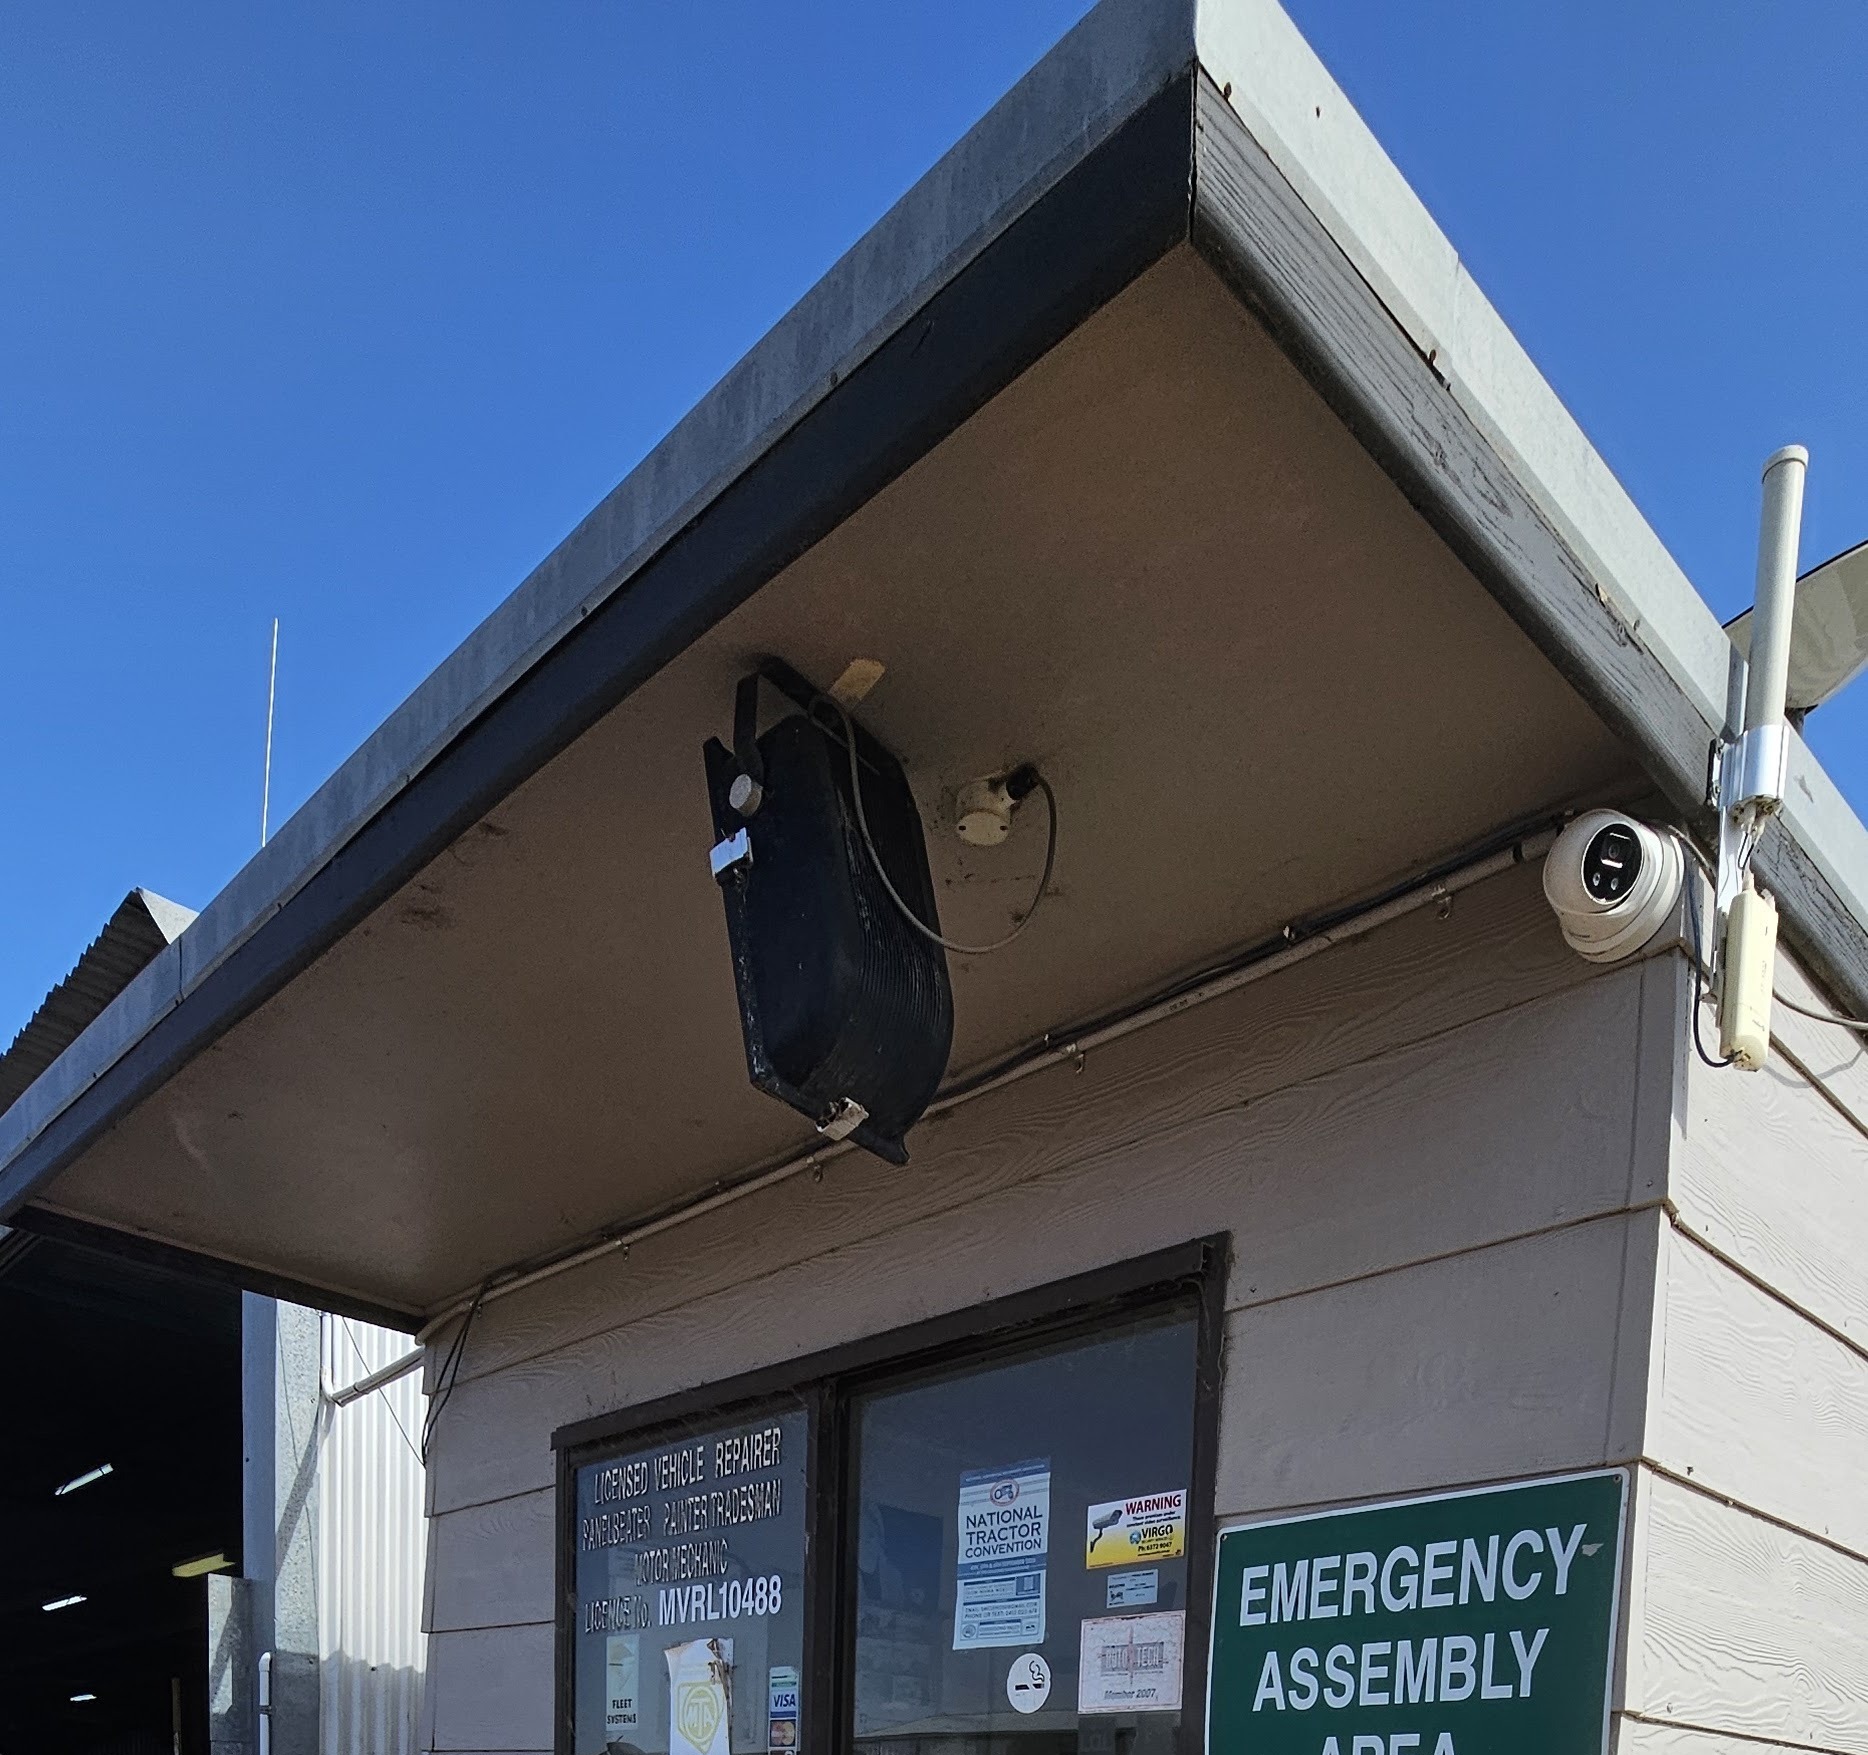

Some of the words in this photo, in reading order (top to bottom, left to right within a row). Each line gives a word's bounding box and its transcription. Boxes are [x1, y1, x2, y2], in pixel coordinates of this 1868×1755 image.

[595, 1461, 648, 1504] LICENSED
[654, 1446, 704, 1491] VEHICLE
[715, 1427, 782, 1478] REPAIRER
[582, 1505, 651, 1551] PANELBEATER
[663, 1494, 708, 1536] PAINTER
[711, 1479, 782, 1527] TRADESMAN
[1125, 1494, 1182, 1515] WARNING
[966, 1505, 1043, 1529] NATIONAL
[966, 1521, 1041, 1545] TRACTOR
[1141, 1524, 1173, 1539] VIRGO
[965, 1538, 1042, 1558] CONVENTION
[635, 1549, 669, 1586] MOTOR
[673, 1538, 728, 1579] MECHANIC
[1239, 1523, 1588, 1626] EMERGENCY
[659, 1575, 782, 1625] MVRL10488
[1252, 1628, 1549, 1711] ASSEMBLY
[612, 1698, 633, 1709] FLEET
[773, 1694, 796, 1707] VISA
[606, 1713, 637, 1725] SYSTEMS
